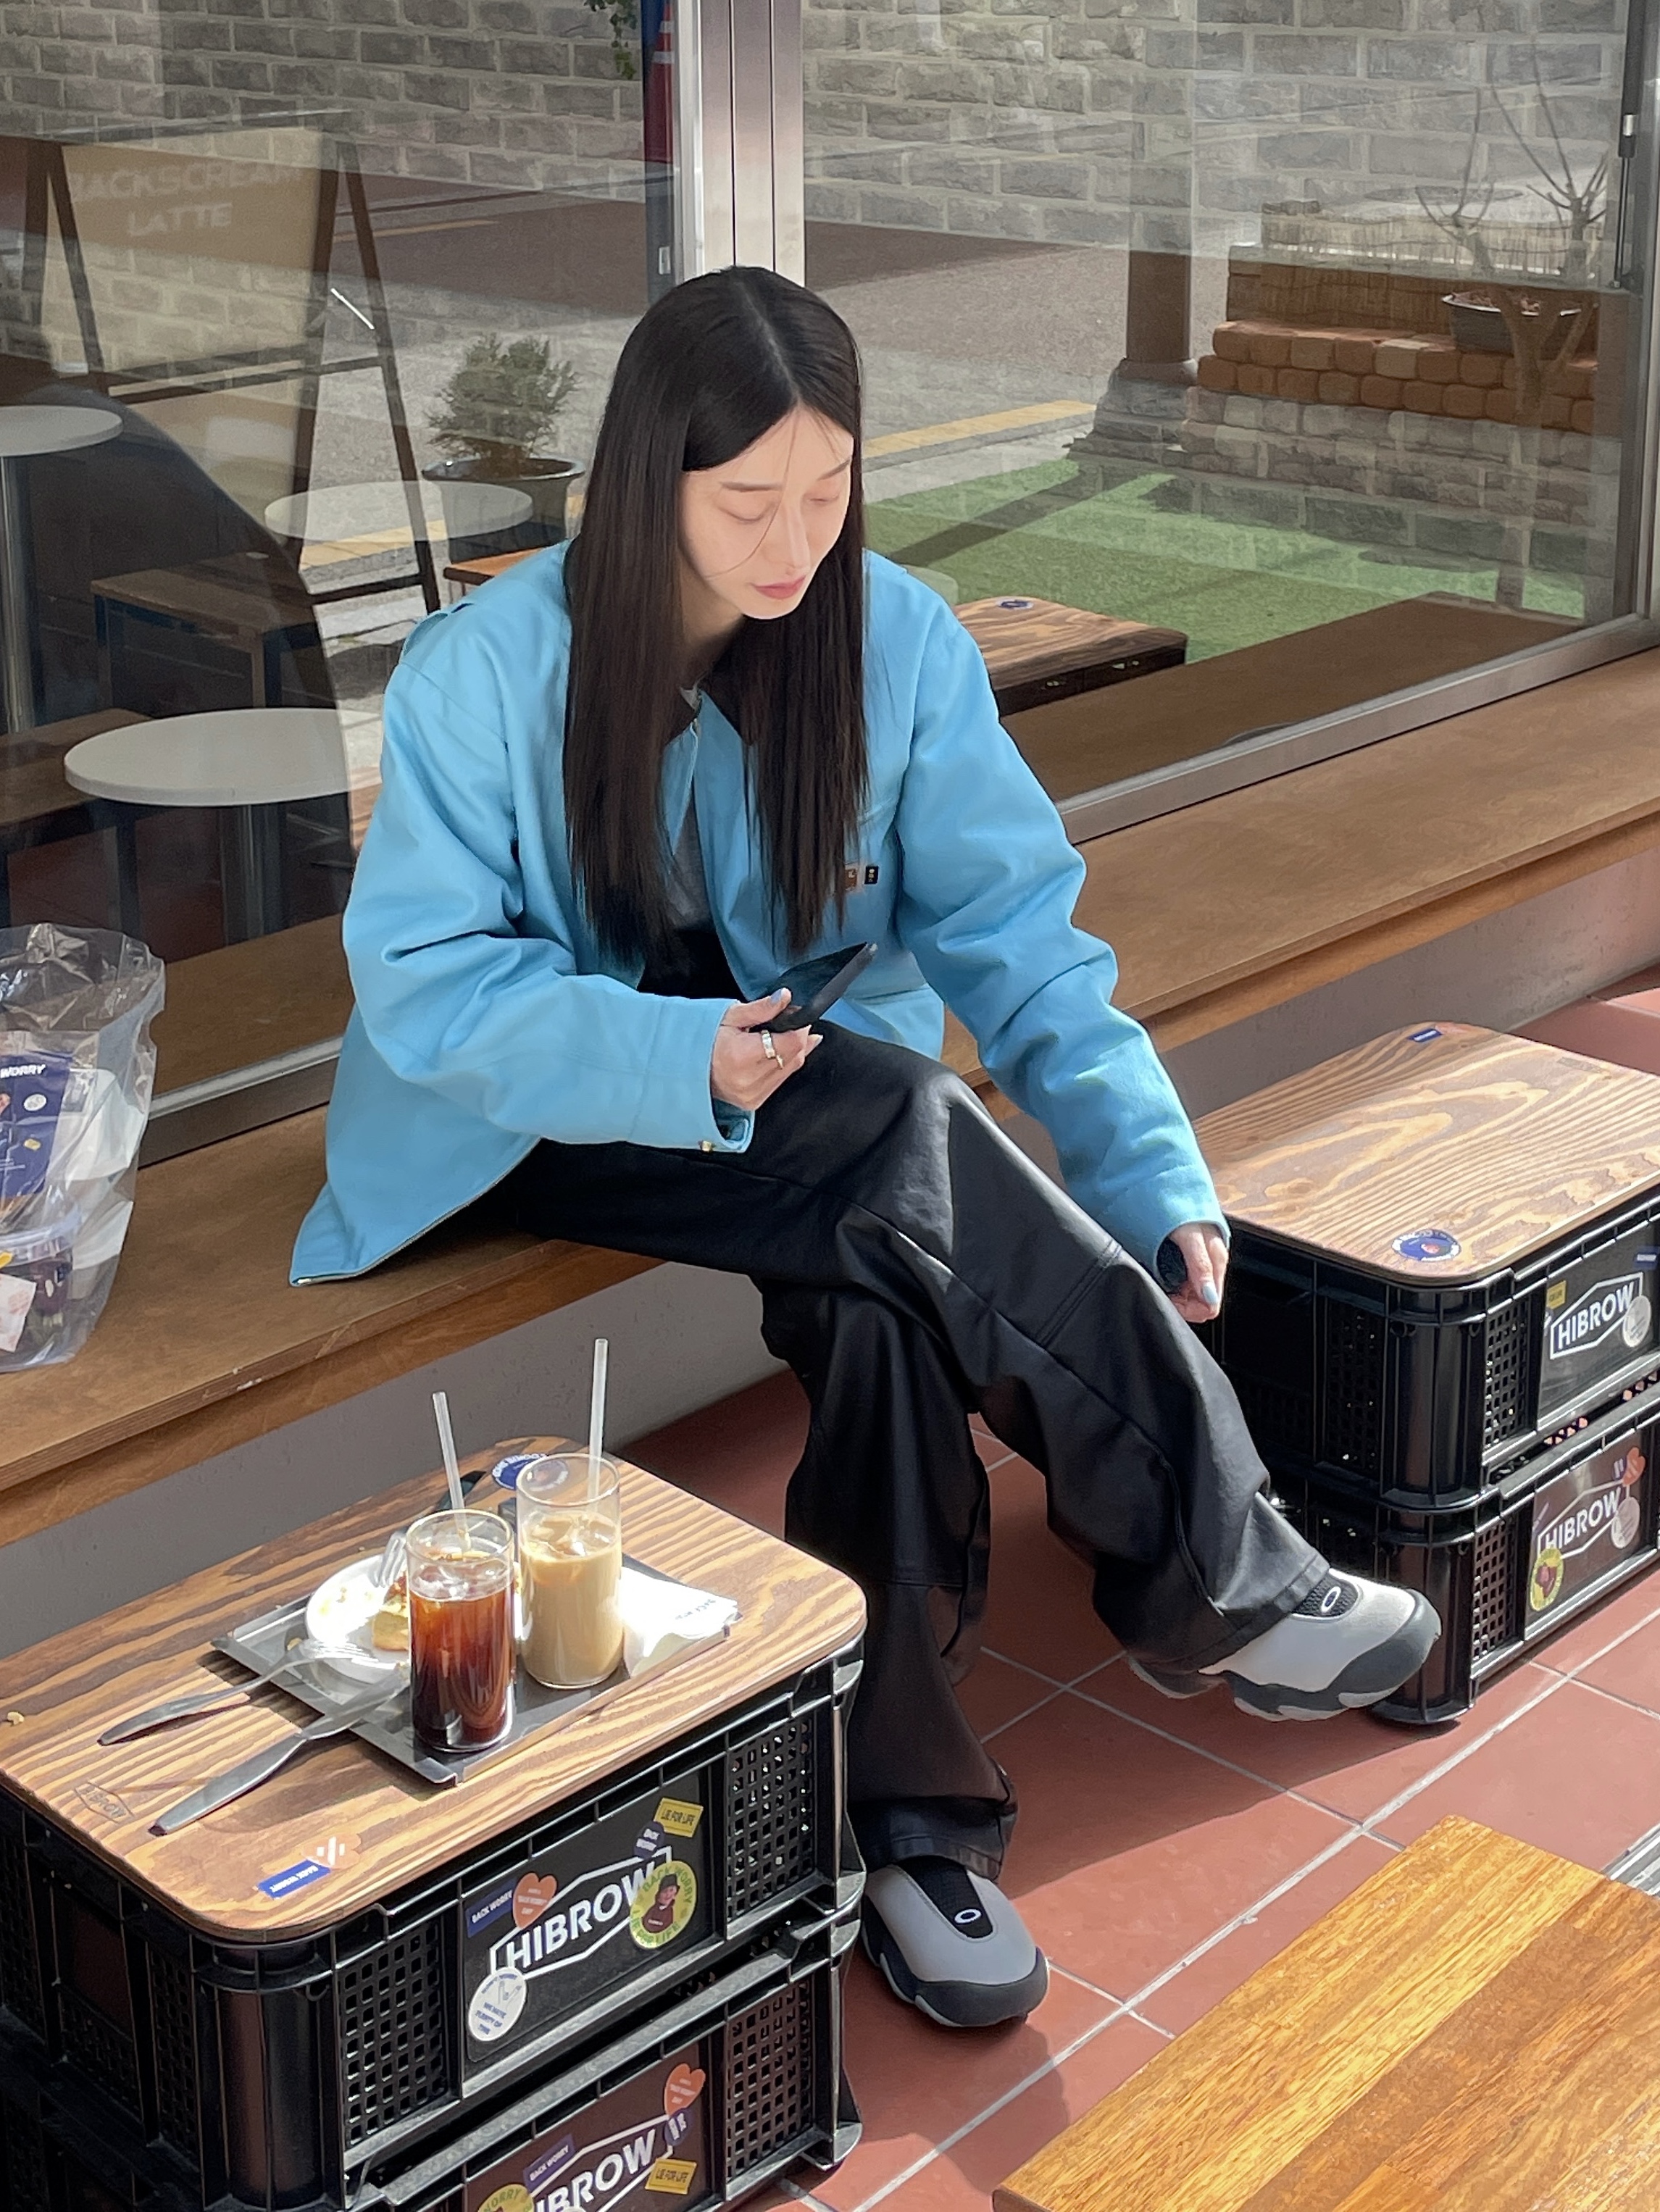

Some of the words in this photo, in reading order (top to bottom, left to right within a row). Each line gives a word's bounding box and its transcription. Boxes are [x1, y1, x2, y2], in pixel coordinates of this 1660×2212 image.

[128, 202, 233, 237] LATTE
[1559, 1281, 1635, 1350] HIBROW
[1546, 1487, 1621, 1549] HIBROW
[77, 1785, 128, 1818] HIBROW
[675, 1865, 693, 1903] WORRY
[472, 1906, 490, 1924] BACK
[488, 1890, 513, 1911] WORRY
[507, 1861, 655, 1969] HIBROW
[529, 2163, 548, 2182] BACK
[546, 2145, 569, 2167] WORRY
